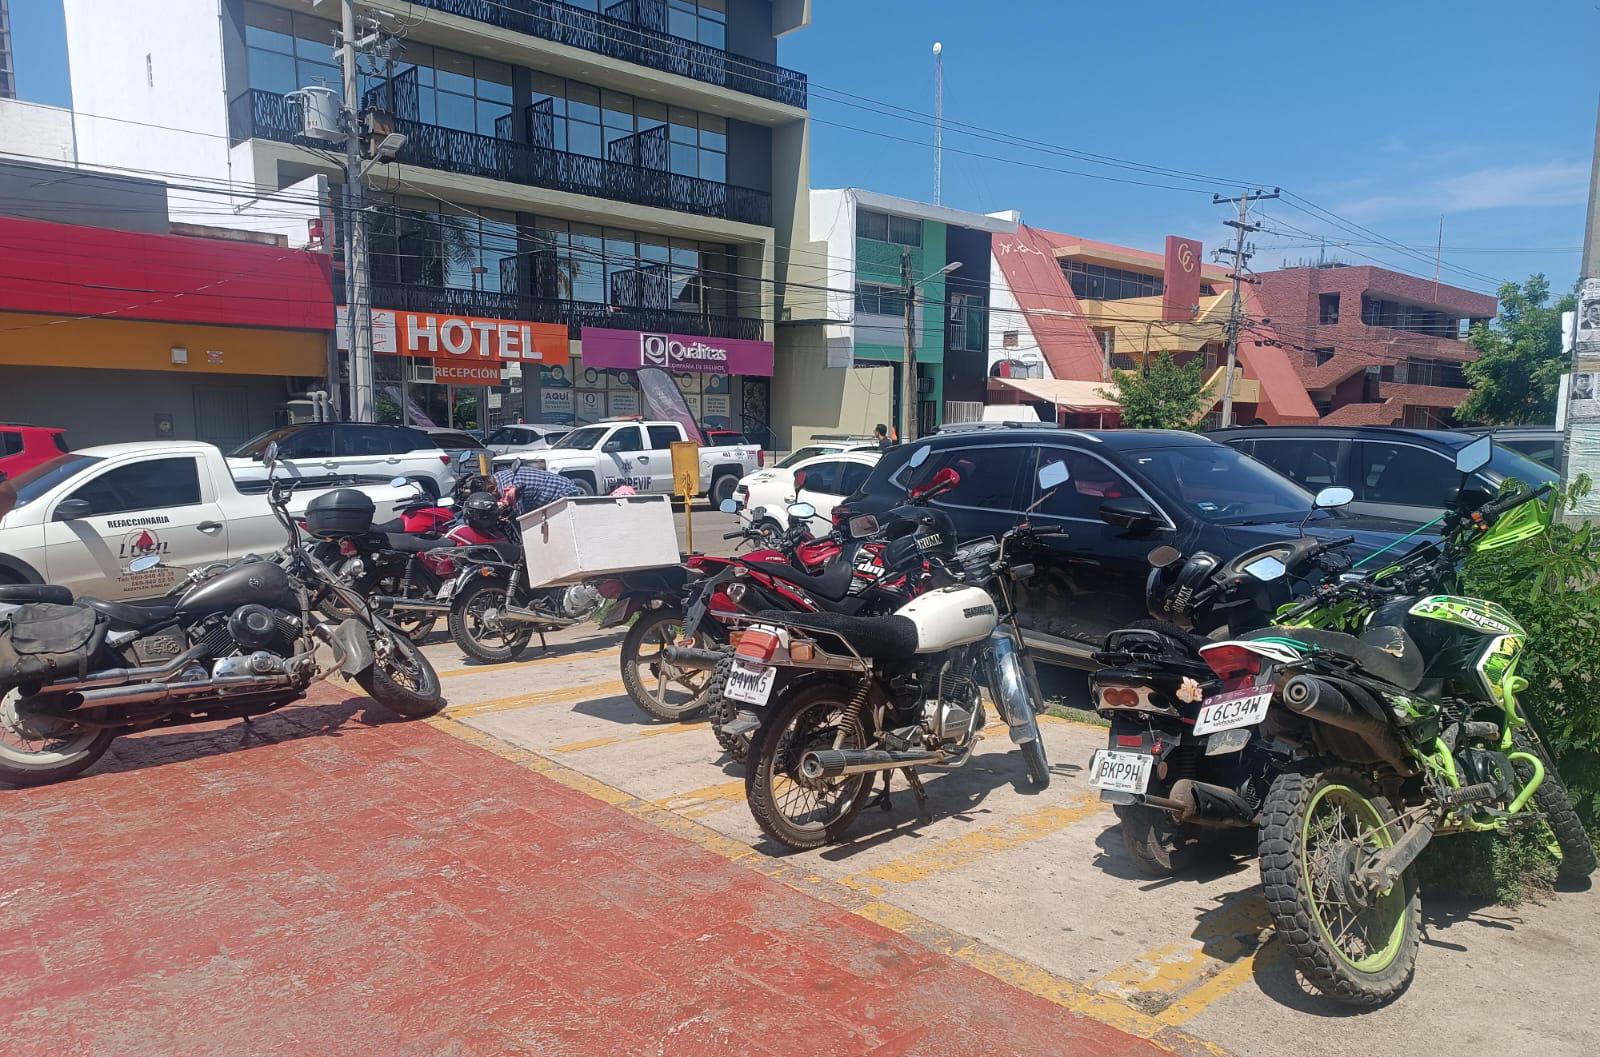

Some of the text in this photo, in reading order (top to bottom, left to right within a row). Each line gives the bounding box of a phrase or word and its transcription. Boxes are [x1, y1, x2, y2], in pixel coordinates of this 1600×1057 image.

[407, 314, 543, 360] HOTEL
[435, 366, 498, 380] RECEPCIÓN
[107, 516, 170, 528] REFACCIONARIA
[1203, 696, 1262, 724] L6C34W
